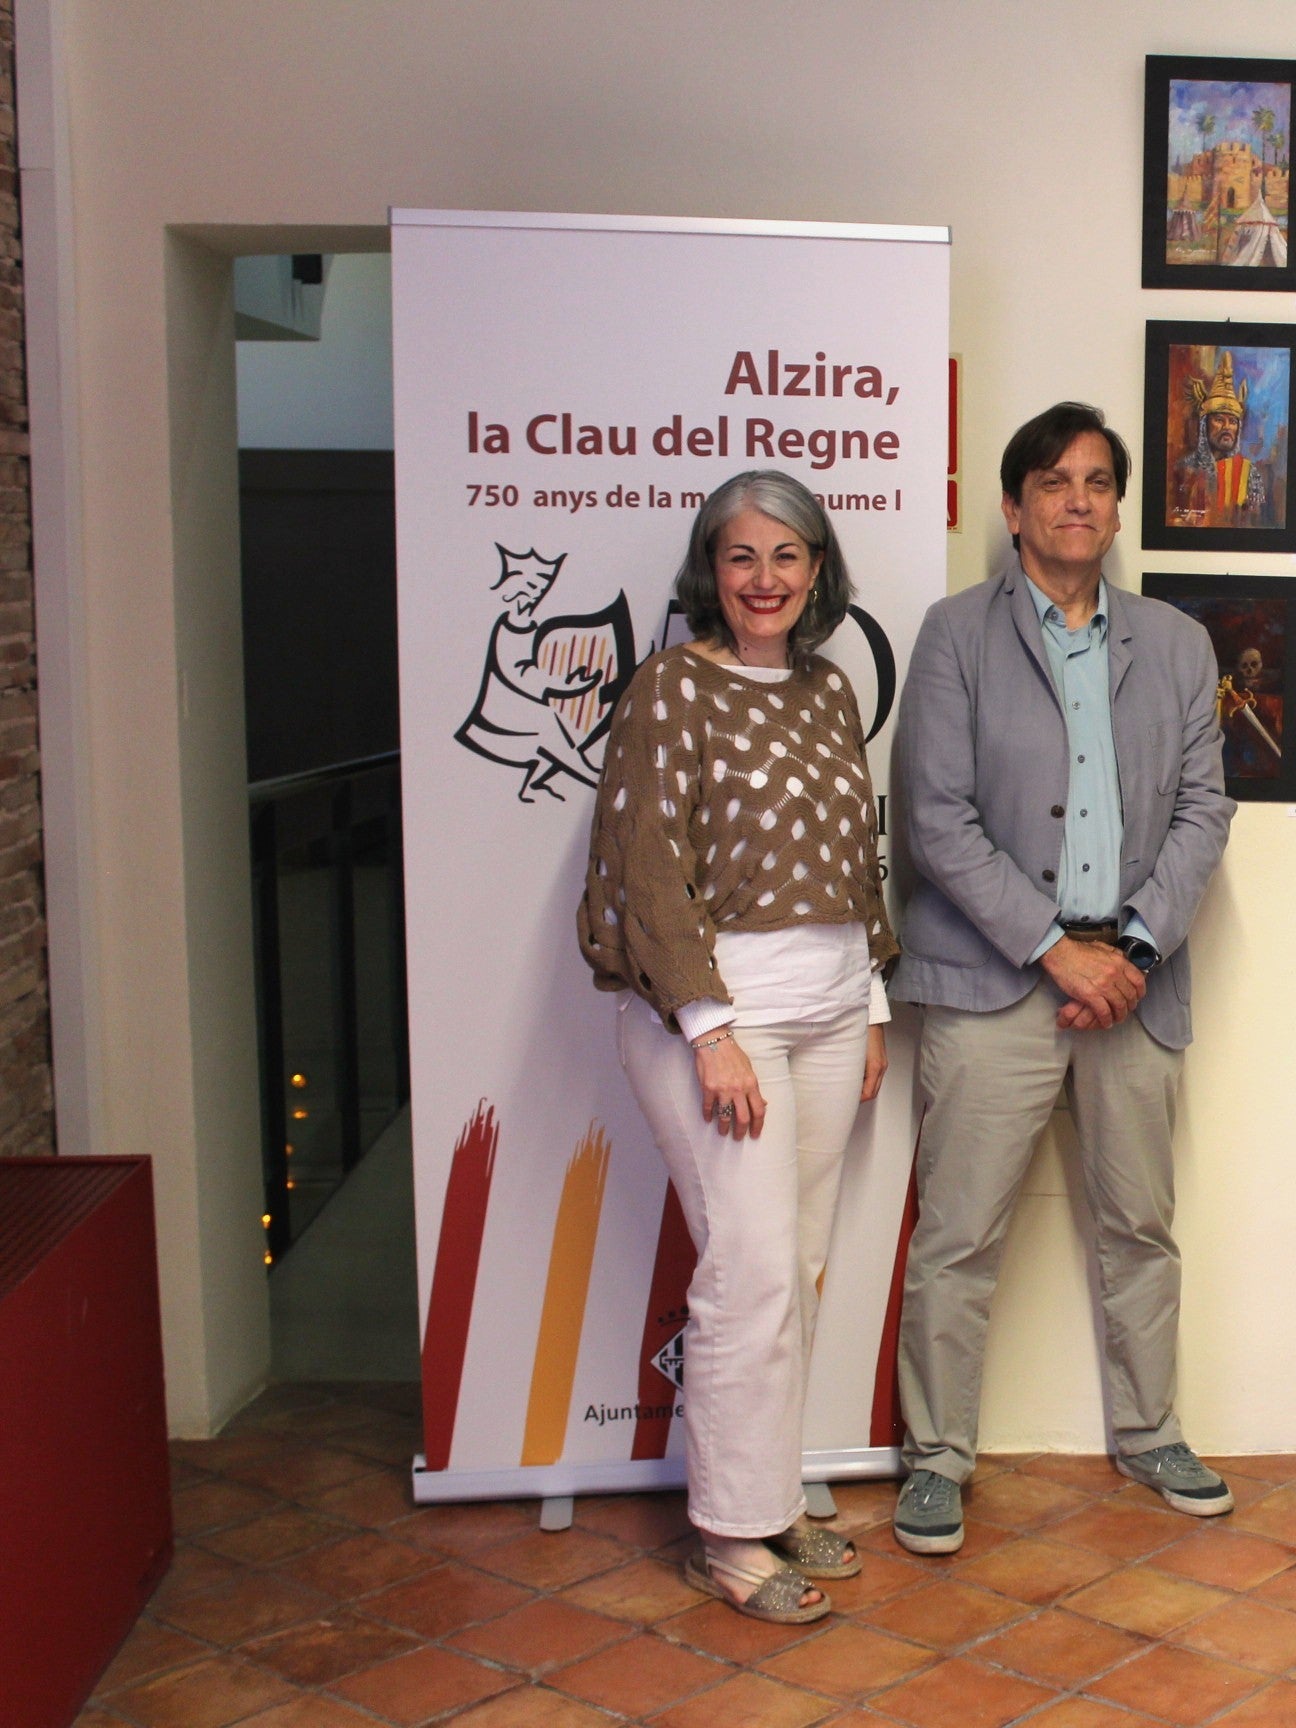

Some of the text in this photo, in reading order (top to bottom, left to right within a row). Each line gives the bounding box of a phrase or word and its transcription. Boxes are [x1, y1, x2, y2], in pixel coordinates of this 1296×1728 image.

[725, 349, 900, 406] Alzira,
[467, 410, 900, 470] la Clau del Regne
[465, 484, 520, 508] 750
[532, 489, 598, 514] anys
[605, 484, 641, 509] de
[648, 484, 672, 509] la
[813, 493, 887, 511] aume
[584, 1404, 685, 1427] Ajuntame
